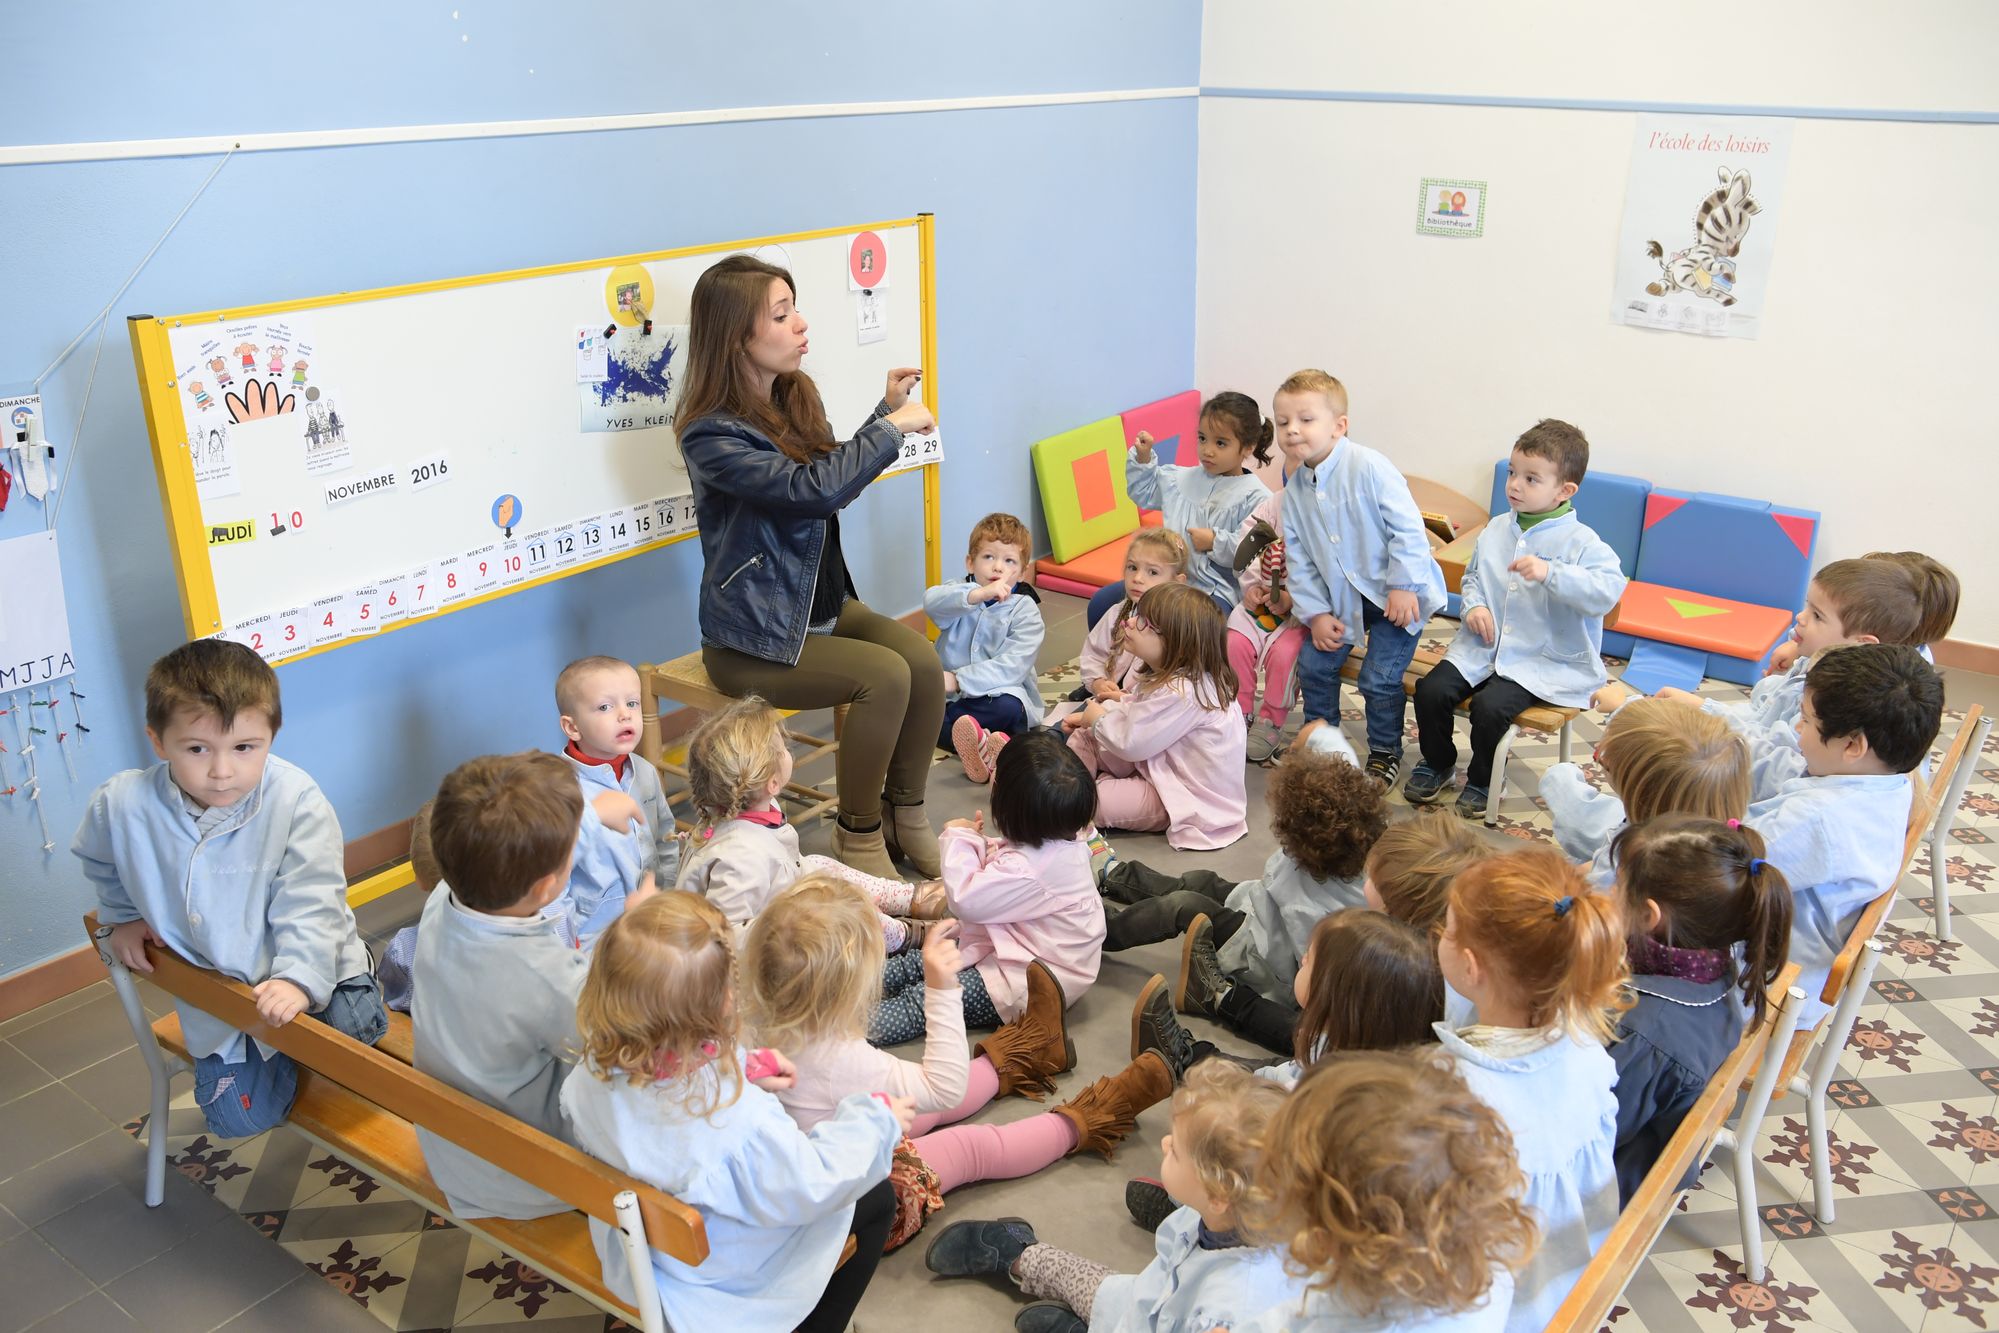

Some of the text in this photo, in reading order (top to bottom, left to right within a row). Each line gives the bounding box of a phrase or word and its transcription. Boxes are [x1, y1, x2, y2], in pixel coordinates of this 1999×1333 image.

[1649, 131, 1771, 154] l'école des loisirs
[0, 396, 40, 408] DIMANCHE
[607, 418, 633, 429] YVES
[904, 444, 917, 458] 28
[924, 440, 937, 453] 29
[328, 473, 395, 501] NOVEMBRE
[411, 460, 448, 484] 2016
[609, 510, 624, 519] LUNDI
[633, 503, 649, 512] MARDI
[685, 505, 696, 520] 17
[635, 516, 651, 533] 15
[659, 510, 673, 525] 16
[524, 530, 550, 541] VENDREDI
[584, 529, 600, 546] 13
[610, 523, 627, 540] 14
[467, 545, 495, 558] MERCREDI
[557, 537, 574, 554] 12
[530, 545, 546, 562] 11
[440, 557, 459, 567] MARDI
[479, 562, 487, 577] 9
[504, 556, 521, 573] 10
[379, 575, 405, 585] DIMANCHE
[447, 573, 456, 588] 8
[388, 591, 397, 606] 6
[417, 584, 425, 601] 7
[313, 595, 344, 607] VENDREDI
[360, 603, 371, 620] 5
[380, 610, 405, 620] NOVEMBRE
[411, 605, 435, 615] NOVEMBRE
[235, 615, 271, 630] MERCREDI
[322, 611, 334, 627] 4
[284, 624, 296, 642] 3
[351, 625, 377, 633] NOVEMBRE
[250, 632, 264, 650] 2
[315, 632, 343, 643] NOVEMBRE
